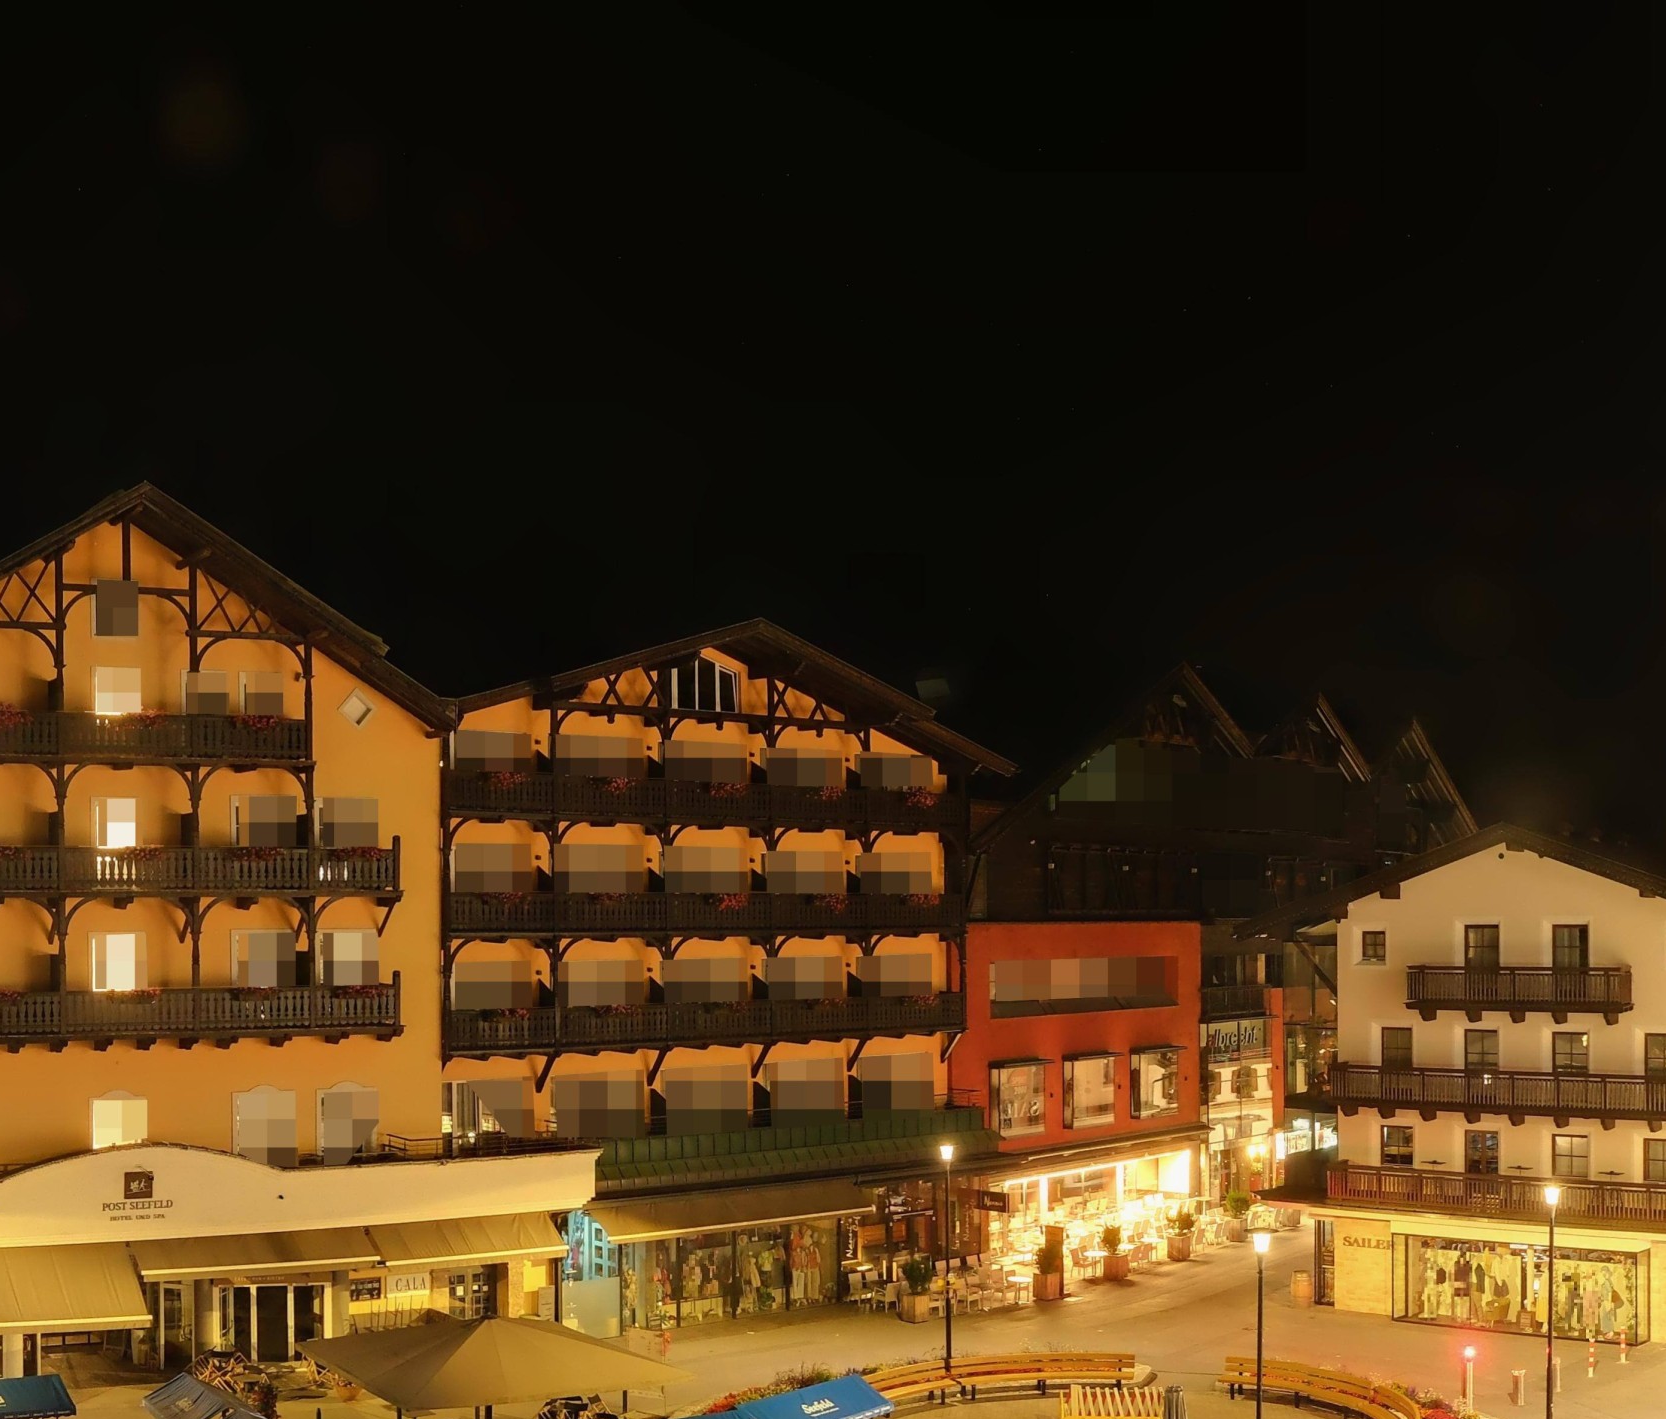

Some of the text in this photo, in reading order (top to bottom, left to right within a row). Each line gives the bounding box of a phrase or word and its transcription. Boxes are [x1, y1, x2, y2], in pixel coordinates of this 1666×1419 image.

[102, 1199, 174, 1212] POST SEEFELD
[394, 1277, 427, 1292] CALA
[802, 1398, 835, 1415] Seefeld
